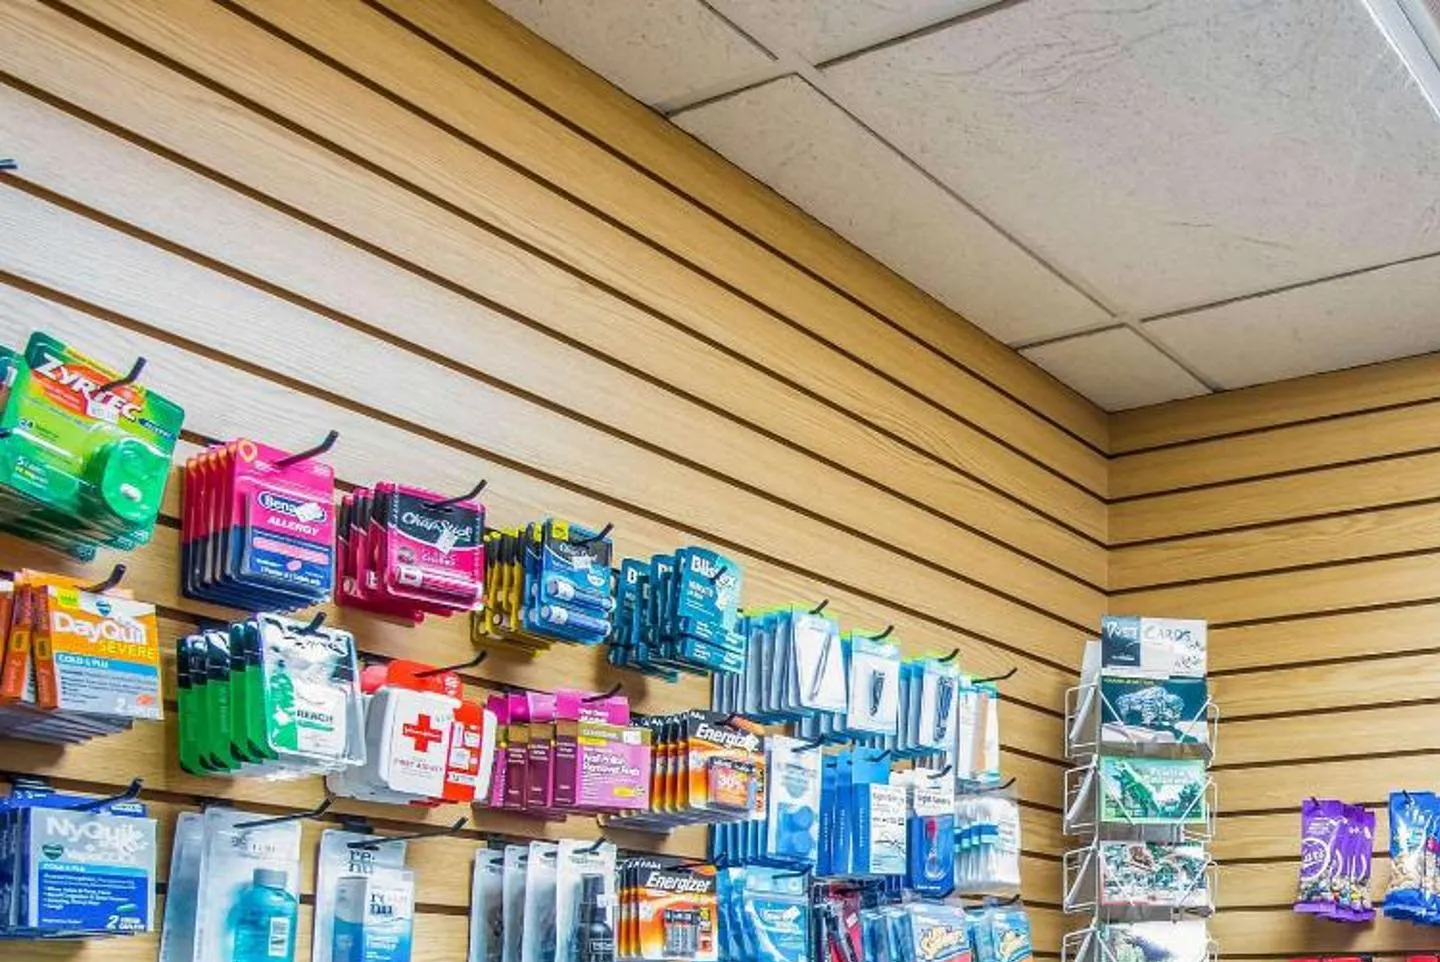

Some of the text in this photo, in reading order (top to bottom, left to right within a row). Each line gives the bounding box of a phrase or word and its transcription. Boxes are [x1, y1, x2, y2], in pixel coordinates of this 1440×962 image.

[264, 494, 324, 521] Bena
[267, 516, 319, 536] ALLERGY
[691, 554, 736, 588] Blisex
[54, 609, 147, 645] DayQuil
[100, 640, 156, 660] SEVERE
[696, 722, 760, 752] Energiz
[46, 815, 138, 844] NyQuil
[645, 871, 711, 893] Energizer
